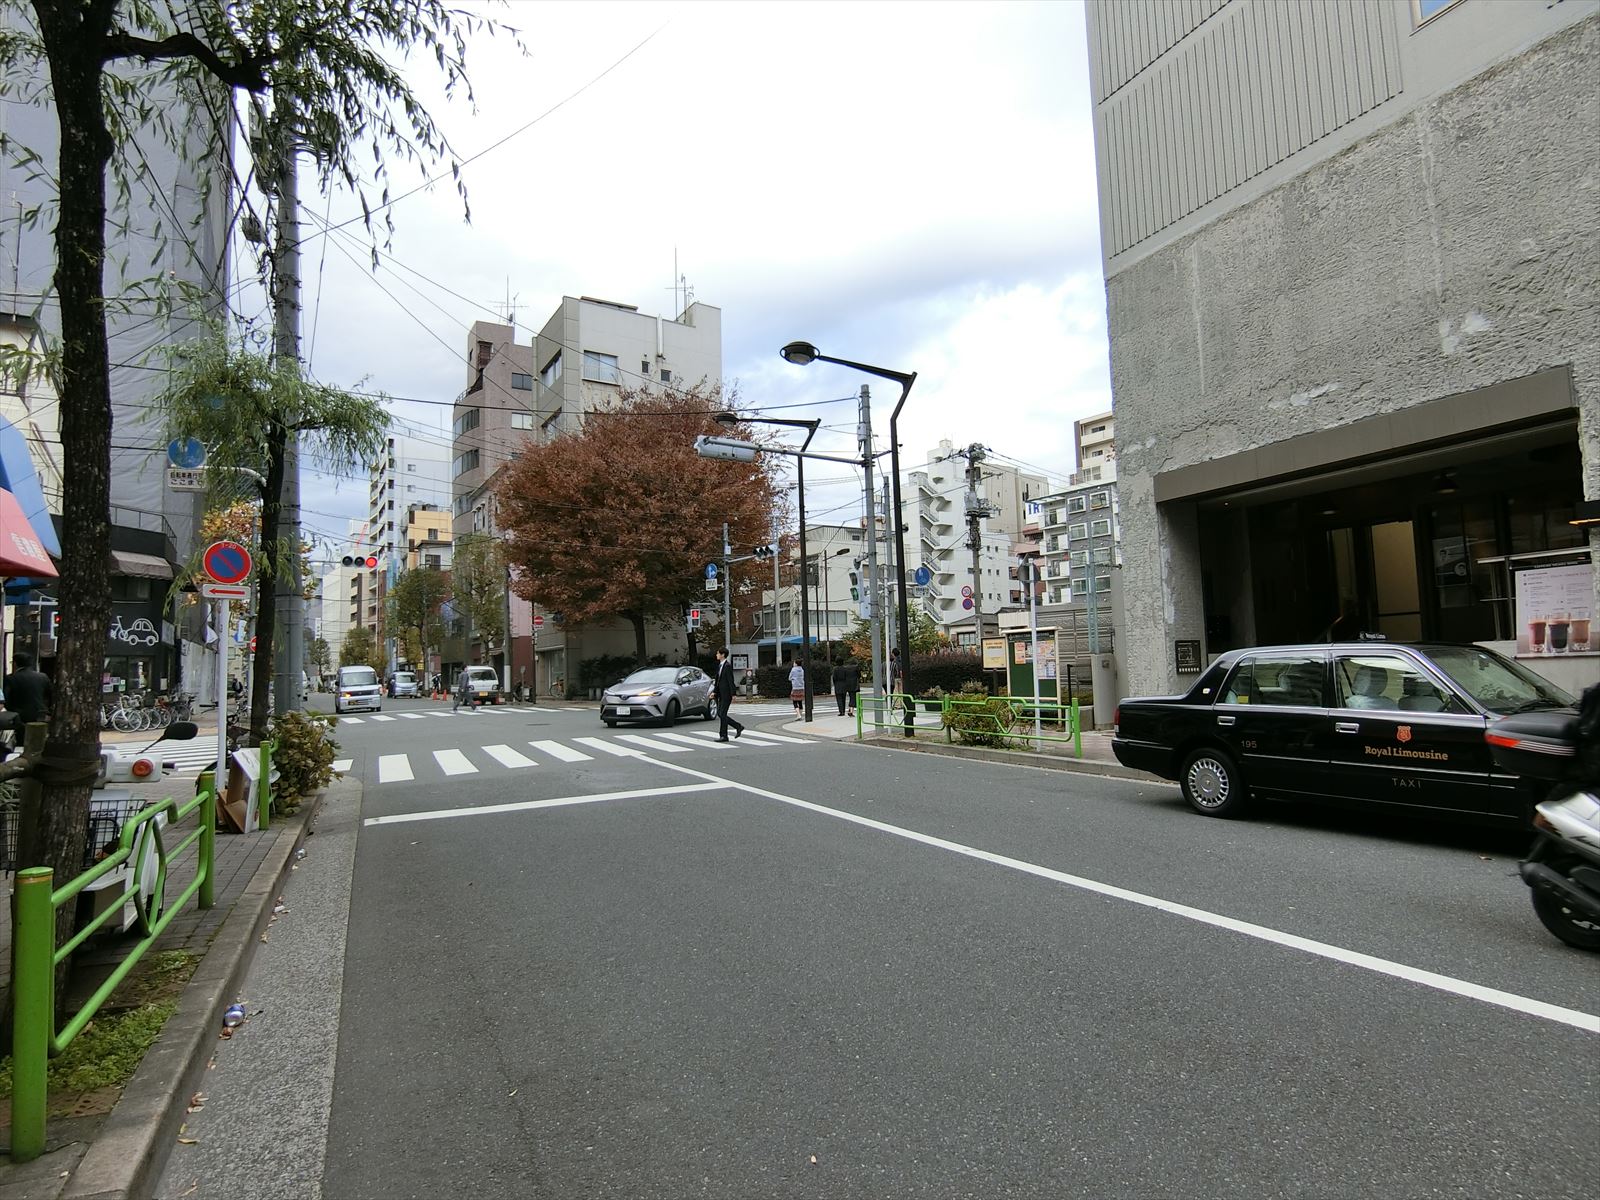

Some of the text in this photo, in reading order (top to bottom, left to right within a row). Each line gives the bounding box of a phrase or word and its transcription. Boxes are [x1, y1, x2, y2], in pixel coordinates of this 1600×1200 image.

[1241, 740, 1257, 748] 195
[1364, 745, 1449, 761] Royal Limousine
[1391, 778, 1421, 788] TAXI
